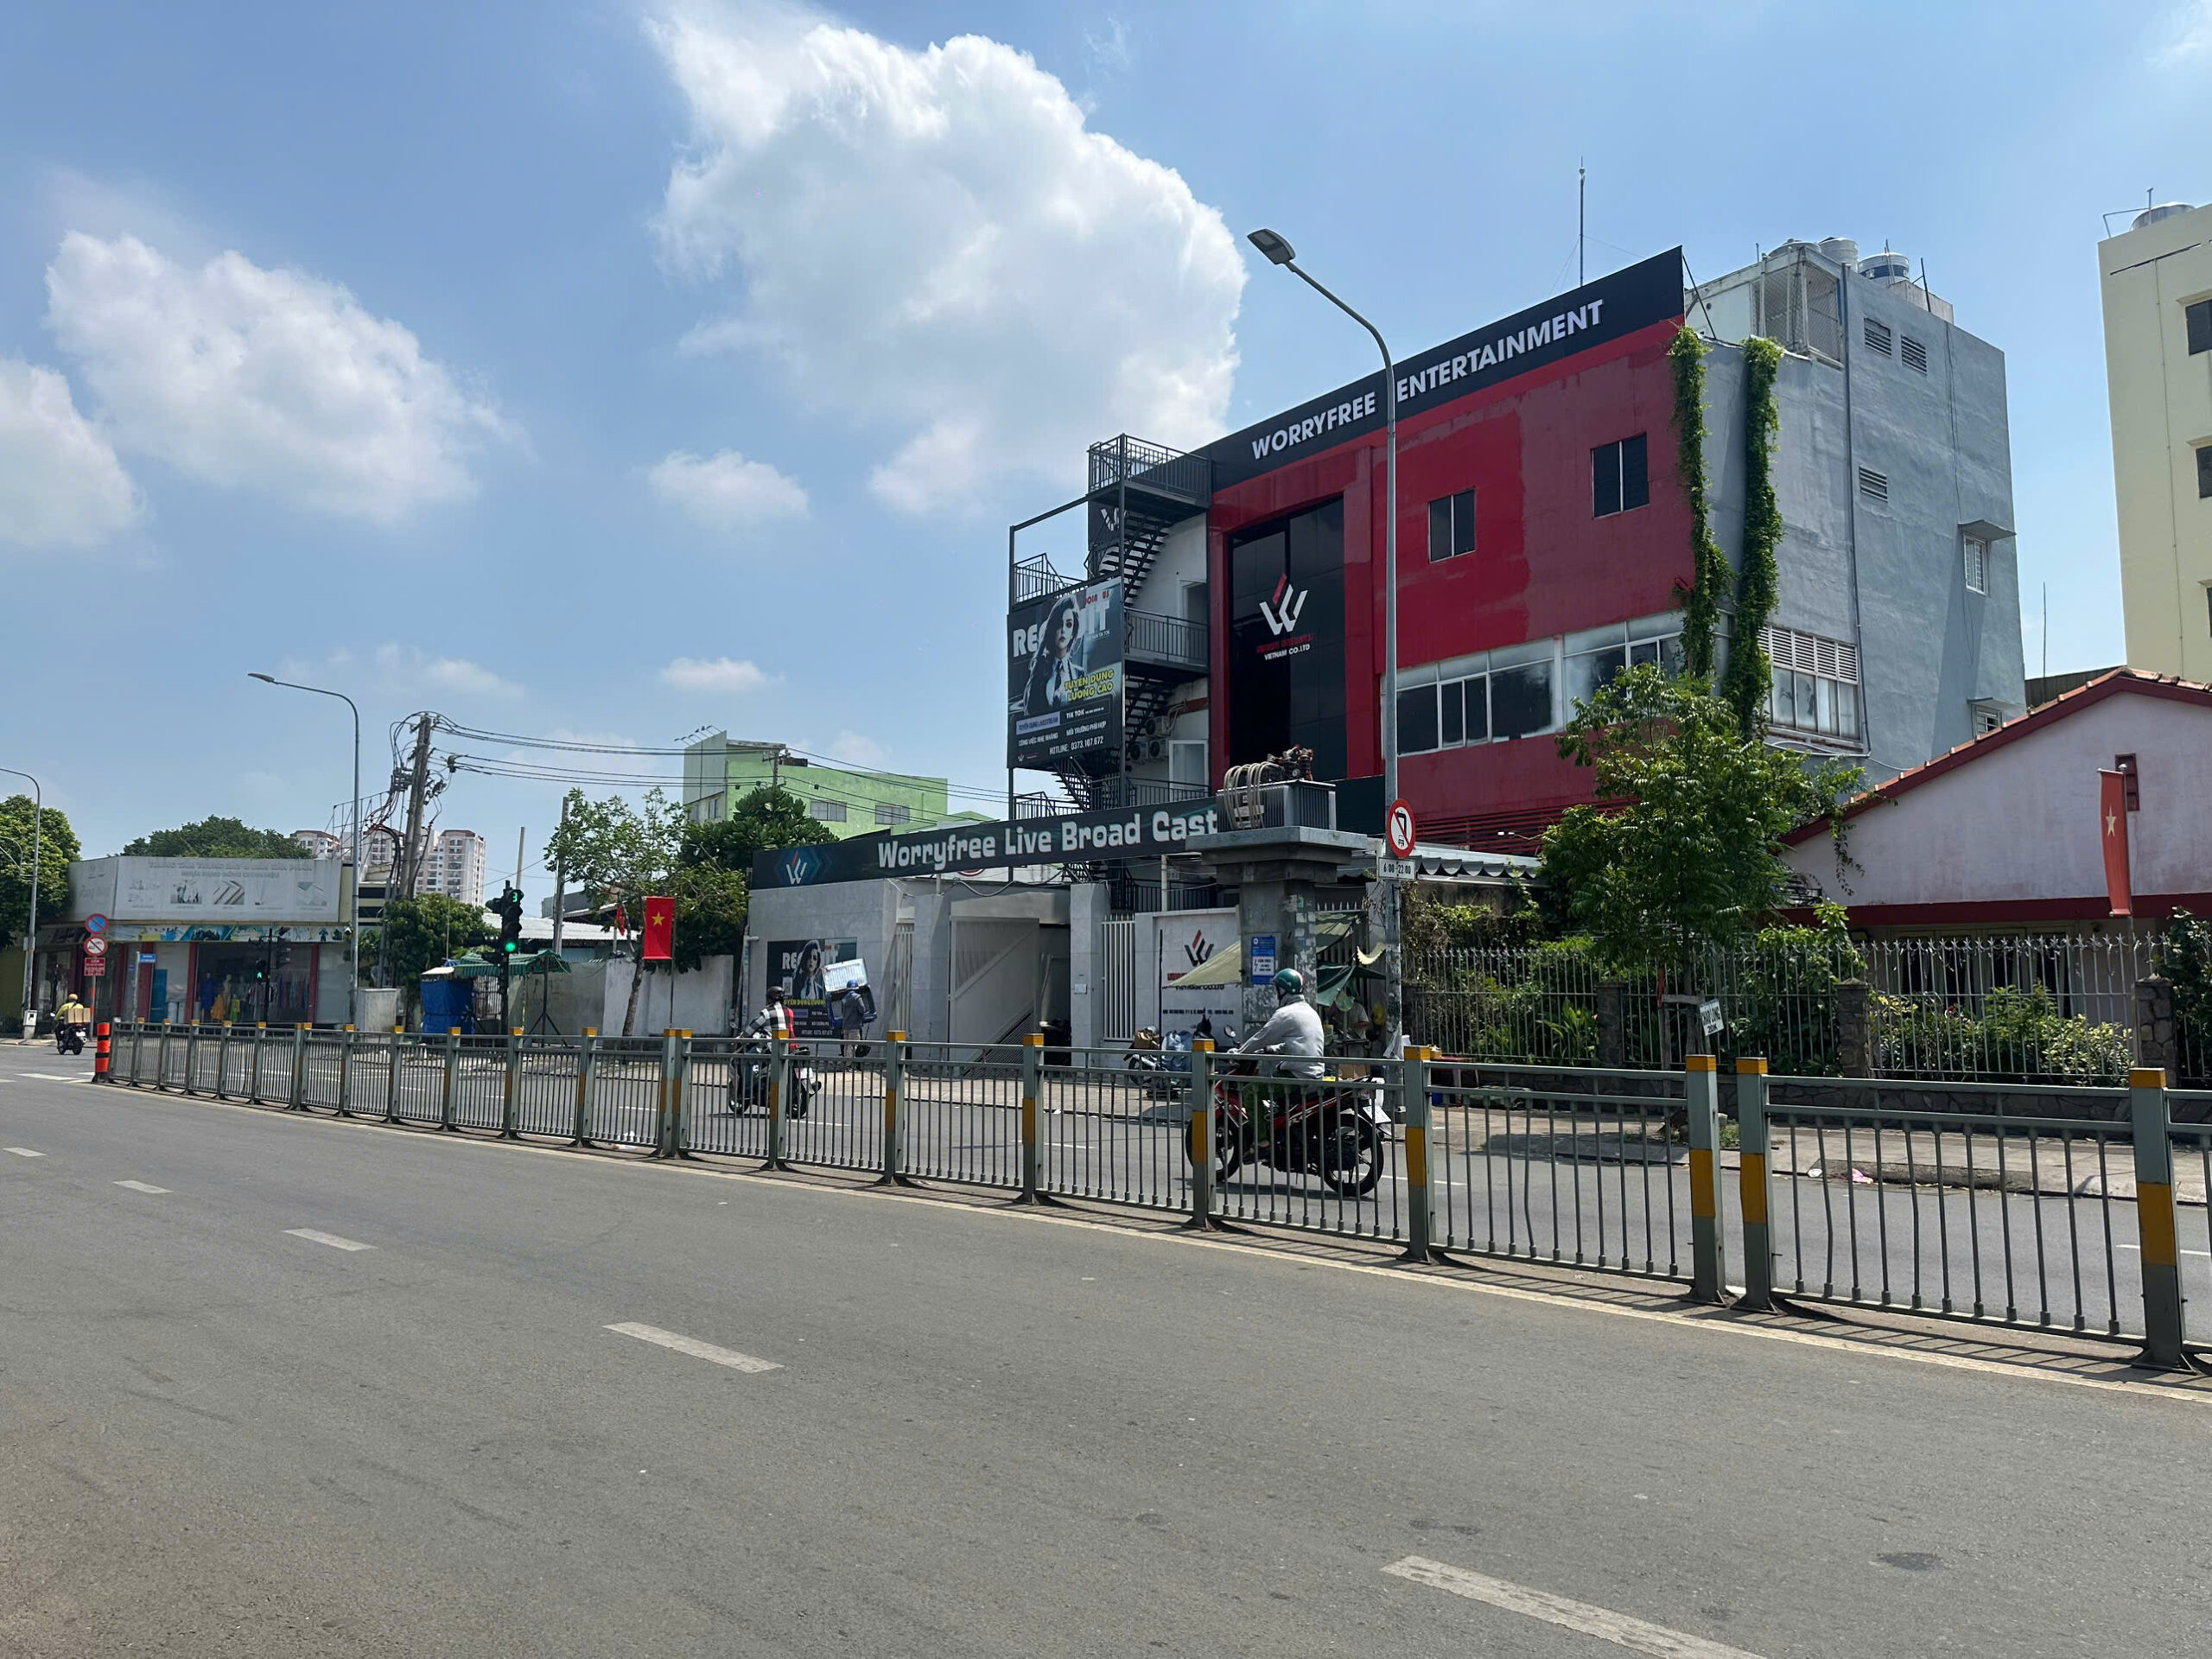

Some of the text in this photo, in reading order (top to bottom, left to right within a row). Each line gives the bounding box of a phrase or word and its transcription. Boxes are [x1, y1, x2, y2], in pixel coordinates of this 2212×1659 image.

[1251, 299, 1604, 460] WORRYFREE ENTERTAINMENT
[1288, 643, 1311, 655] CO.LTD
[1074, 709, 1084, 718] TOK
[878, 810, 1218, 871] Worryfree Live Broad Cast
[512, 892, 518, 903] 3
